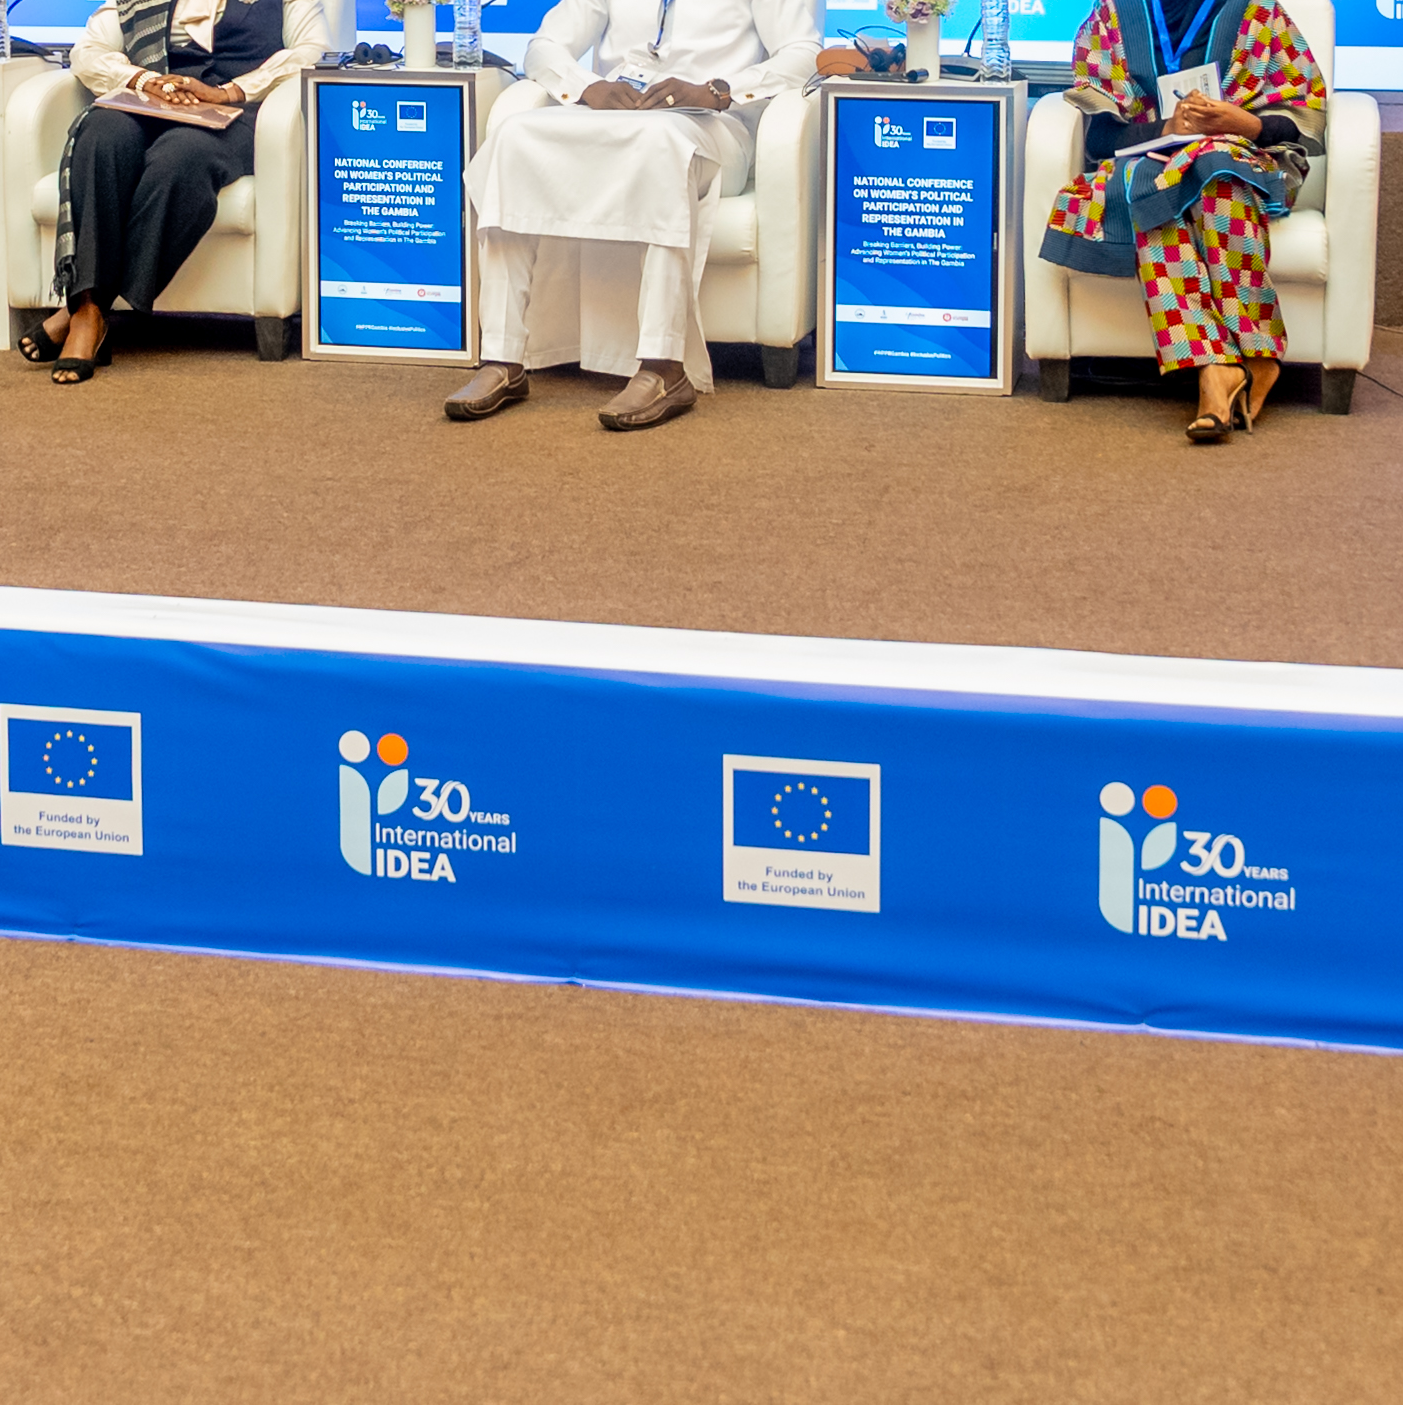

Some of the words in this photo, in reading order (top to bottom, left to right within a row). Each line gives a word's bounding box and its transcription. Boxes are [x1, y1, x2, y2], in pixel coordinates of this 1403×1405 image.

[854, 176, 905, 187] NATIONAL
[907, 178, 973, 189] CONFERENCE
[853, 189, 868, 198] ON
[920, 191, 973, 202] POLITICAL
[863, 201, 939, 213] PARTICIPATION
[941, 204, 963, 214] AND
[862, 214, 951, 226] REPRESENTATION
[953, 217, 964, 226] IN
[882, 227, 903, 236] THE
[904, 227, 946, 238] GAMBIA
